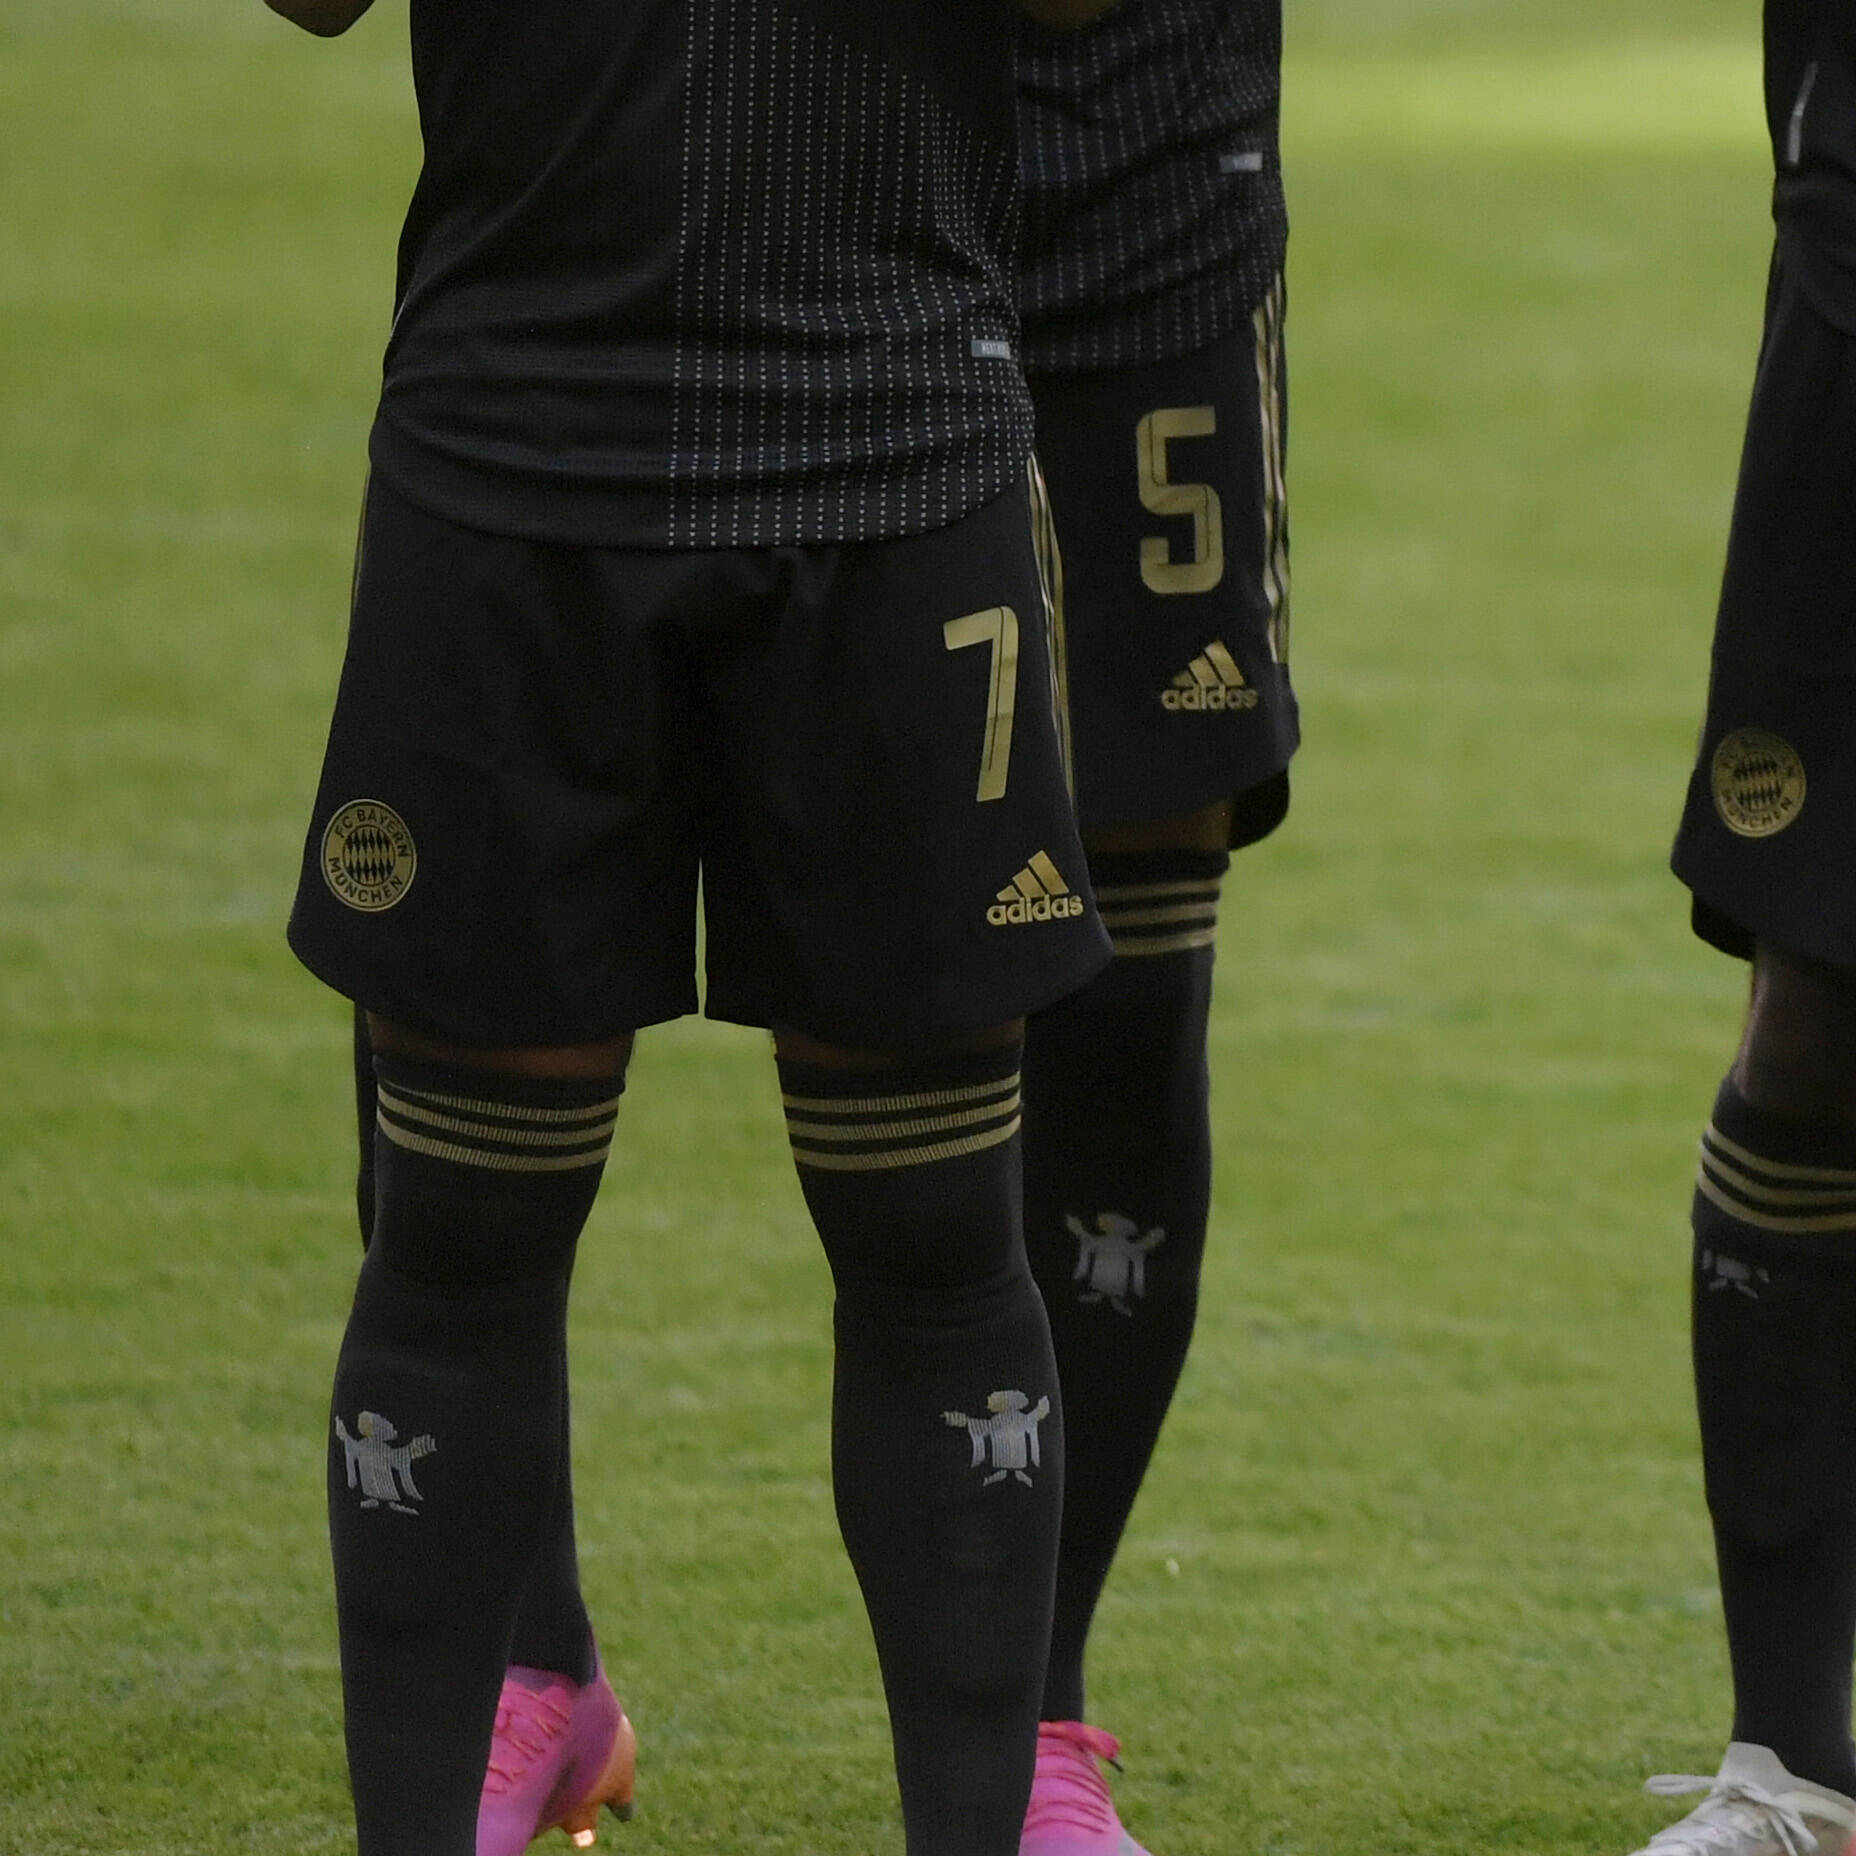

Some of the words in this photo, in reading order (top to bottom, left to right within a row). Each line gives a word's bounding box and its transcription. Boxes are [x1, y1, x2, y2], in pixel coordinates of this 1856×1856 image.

[1135, 406, 1223, 596] 5
[942, 606, 1019, 803] 7
[1161, 685, 1258, 710] adidas
[334, 815, 354, 839] FC
[356, 809, 409, 857] BAYERN
[986, 894, 1084, 925] adidas
